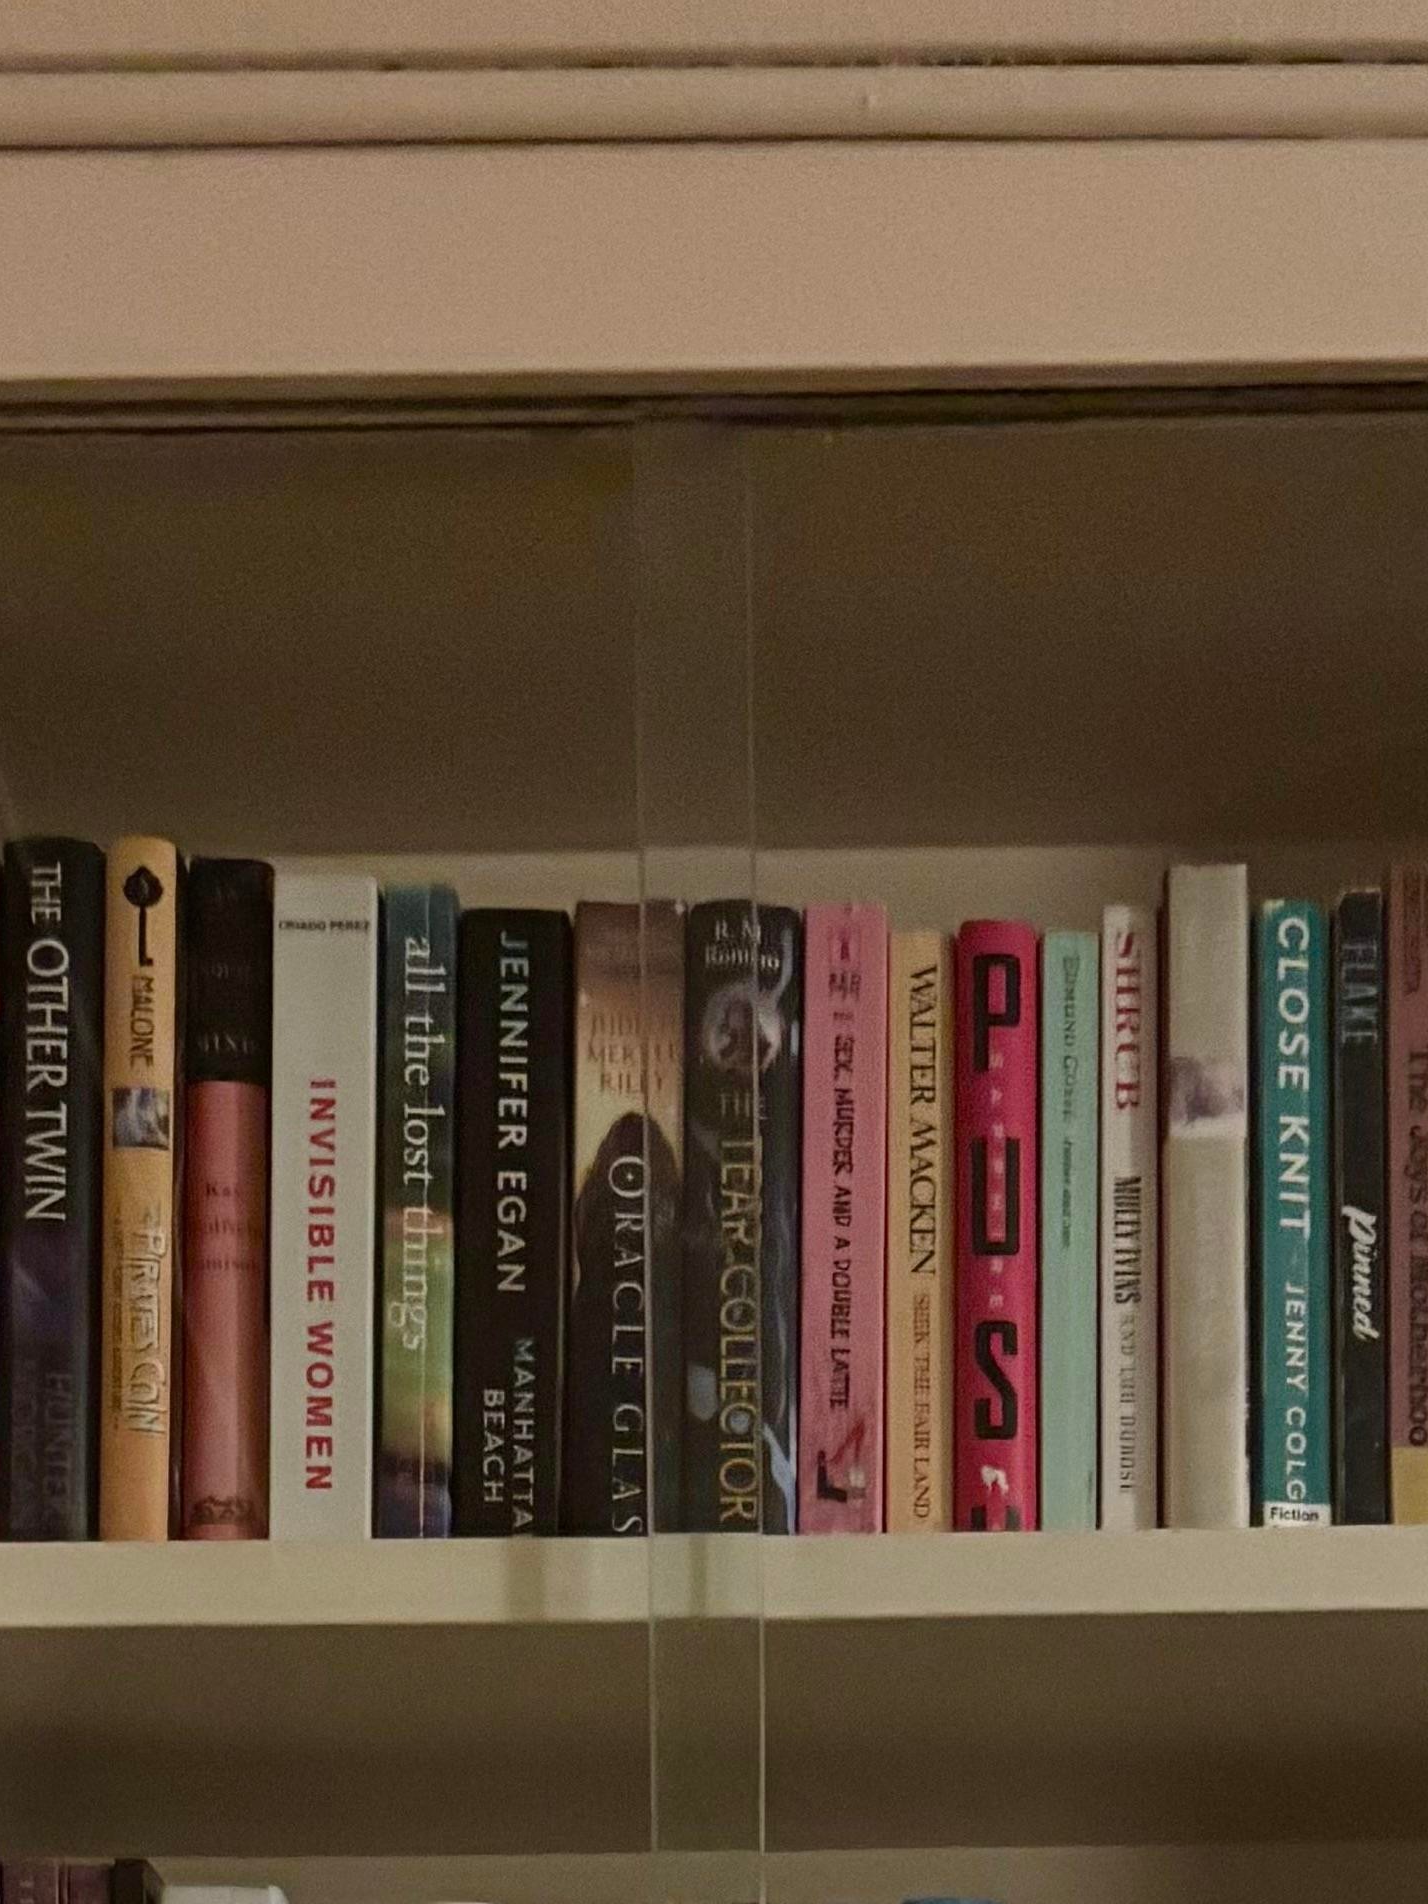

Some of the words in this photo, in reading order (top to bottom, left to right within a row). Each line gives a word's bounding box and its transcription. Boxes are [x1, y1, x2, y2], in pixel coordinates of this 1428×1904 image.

[29, 862, 62, 925] THE
[25, 938, 70, 1092] OTHER
[401, 936, 449, 996] all
[1276, 917, 1311, 1090] CLOSE
[402, 1012, 448, 1086] the
[25, 1101, 69, 1221] TWIN
[305, 1080, 338, 1303] INVISIBLE
[401, 1102, 448, 1186] lost
[1277, 1114, 1311, 1241] KNIT
[388, 1204, 447, 1352] things
[303, 1321, 336, 1490] WOMEN
[1268, 1505, 1321, 1522] Fiction
